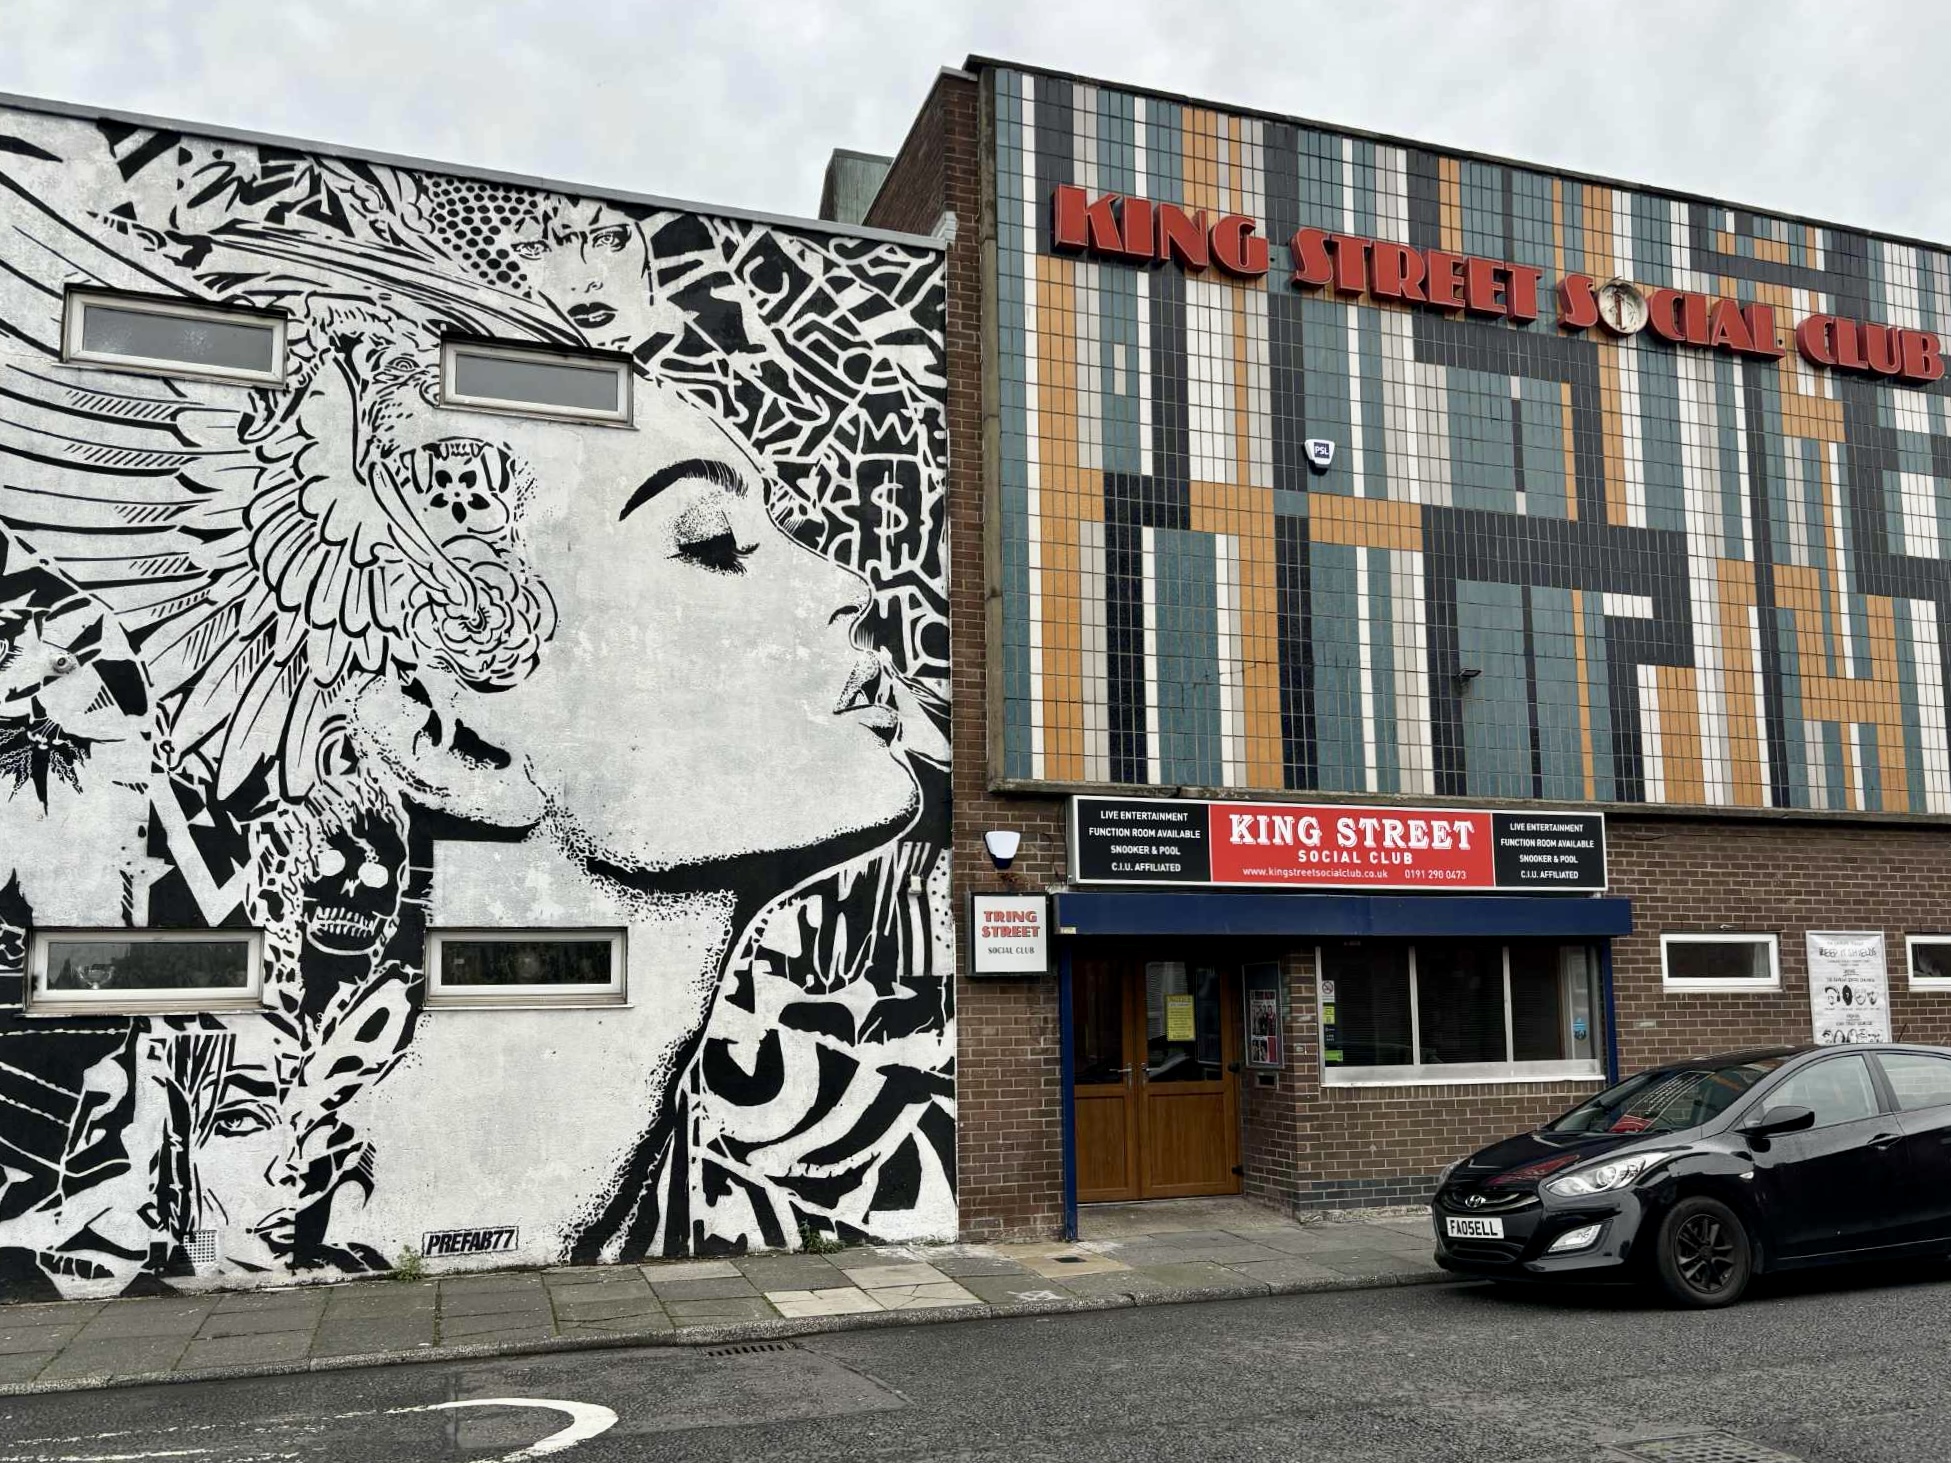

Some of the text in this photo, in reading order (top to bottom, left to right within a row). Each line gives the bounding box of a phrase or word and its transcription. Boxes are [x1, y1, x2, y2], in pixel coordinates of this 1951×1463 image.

[1053, 184, 1946, 385] KING STREET SOCIAL CLUB
[1100, 810, 1189, 822] LIVE ENTERTAINMENT
[1088, 827, 1201, 839] FUNCTION ROOM AVAILABLE
[1229, 814, 1475, 850] KING STREET
[1509, 823, 1583, 833] LIVE ENTERTAINMENT
[1500, 838, 1595, 849] FUNCTION ROOM AVAILABLE
[1110, 845, 1181, 856] SNOOKER & POOL
[1298, 849, 1413, 865] SOCIAL CLUB
[1519, 854, 1579, 864] SNOOKER & POOL
[1111, 862, 1182, 873] C.I.U. AFFILIATED
[1242, 867, 1468, 880] www.kingstreetsocialclub.co.uk 0191 290 0473
[1520, 870, 1579, 880] C.I.U. AFFILIATED
[981, 925, 1041, 938] STREET
[988, 946, 1035, 955] SOCIAL CLUB
[425, 1229, 515, 1255] PREFAB77
